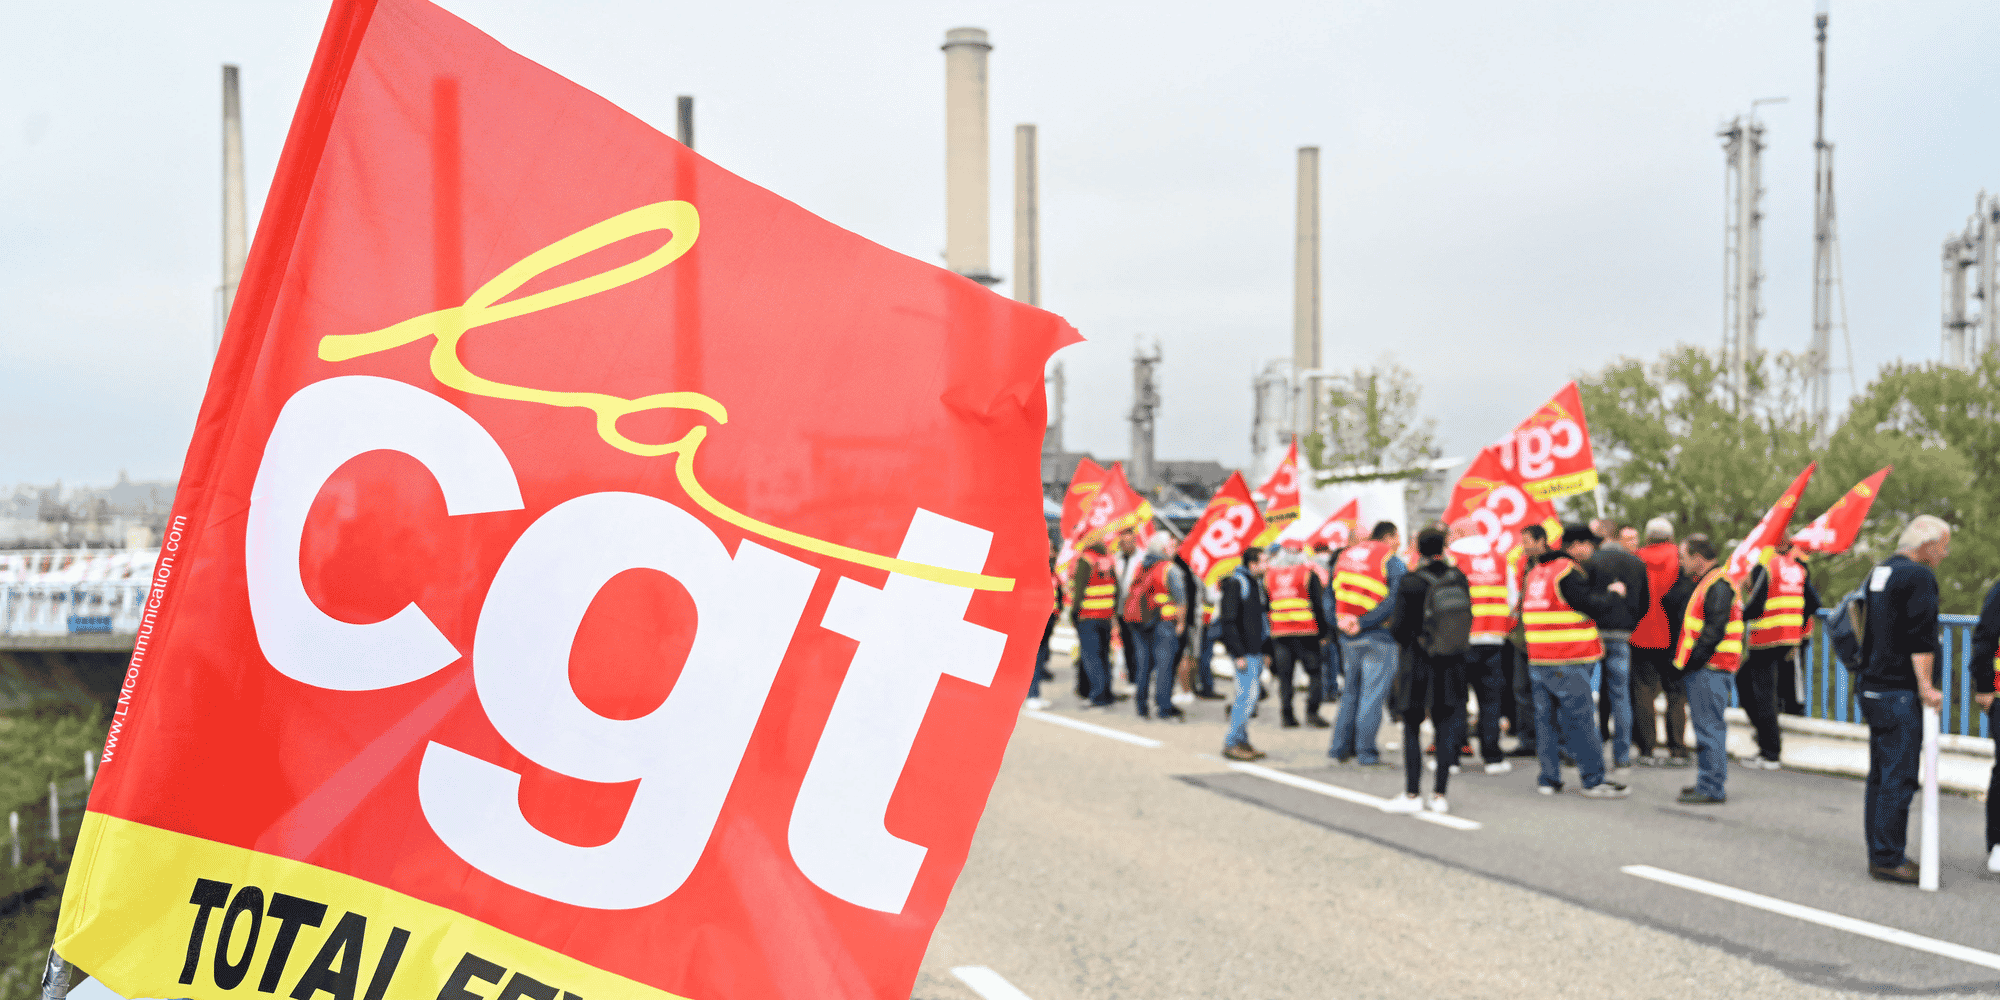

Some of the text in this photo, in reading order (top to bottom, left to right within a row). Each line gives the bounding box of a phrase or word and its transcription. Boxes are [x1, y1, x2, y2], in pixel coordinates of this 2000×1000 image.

[318, 200, 1015, 591] la
[101, 514, 187, 763] www.LMcommunication.com
[246, 375, 1008, 914] cgt
